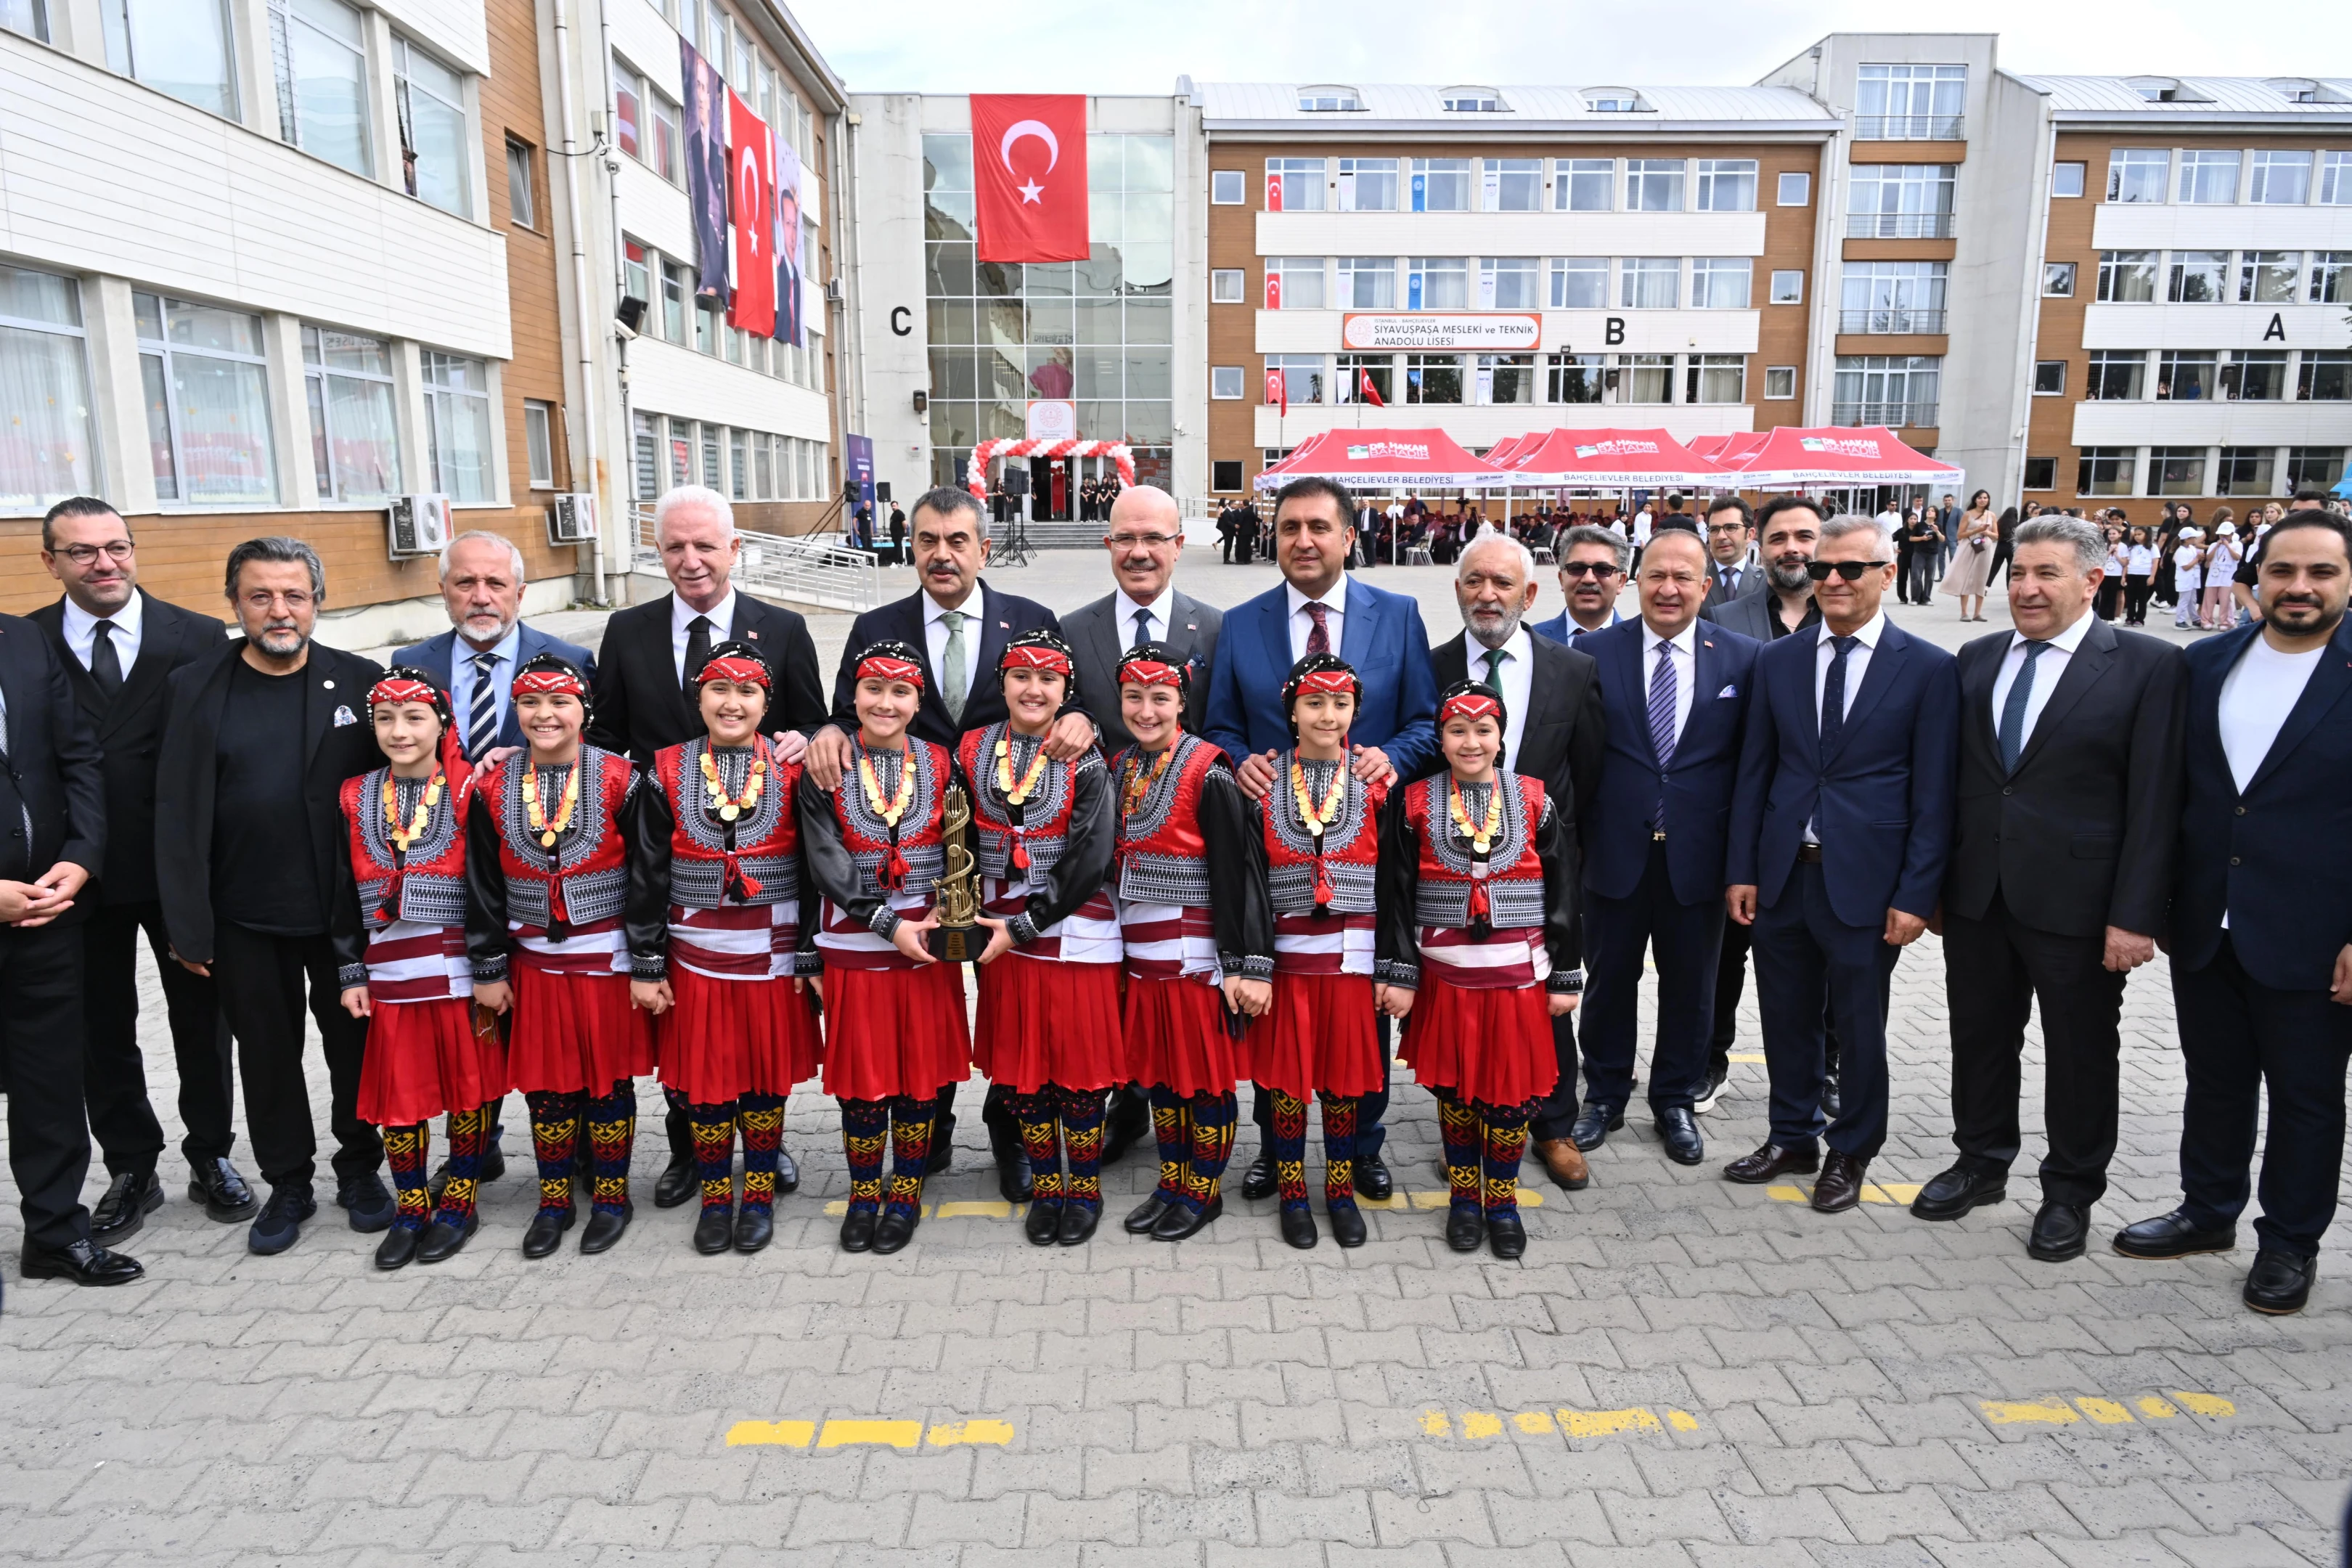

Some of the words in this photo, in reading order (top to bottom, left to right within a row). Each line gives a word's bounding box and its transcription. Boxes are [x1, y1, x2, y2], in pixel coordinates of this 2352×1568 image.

[891, 306, 912, 336] C
[1374, 323, 1439, 335] SİYAVUŞPAŞA
[1442, 323, 1482, 334] MESLEKİ
[1499, 324, 1533, 334] TEKNİK
[1606, 318, 1625, 345] B
[2263, 313, 2285, 340] A
[1427, 335, 1454, 346] LİSESİ
[1389, 441, 1428, 451] HAKAN
[1598, 444, 1659, 453] BAHADIR
[1839, 439, 1879, 449] HAKAN
[1370, 448, 1429, 457] BAHADIR
[1825, 444, 1881, 457] BAHADIR
[1402, 475, 1453, 484] BELEDİYESİ
[1564, 473, 1630, 483] BAHÇELİEVLER
